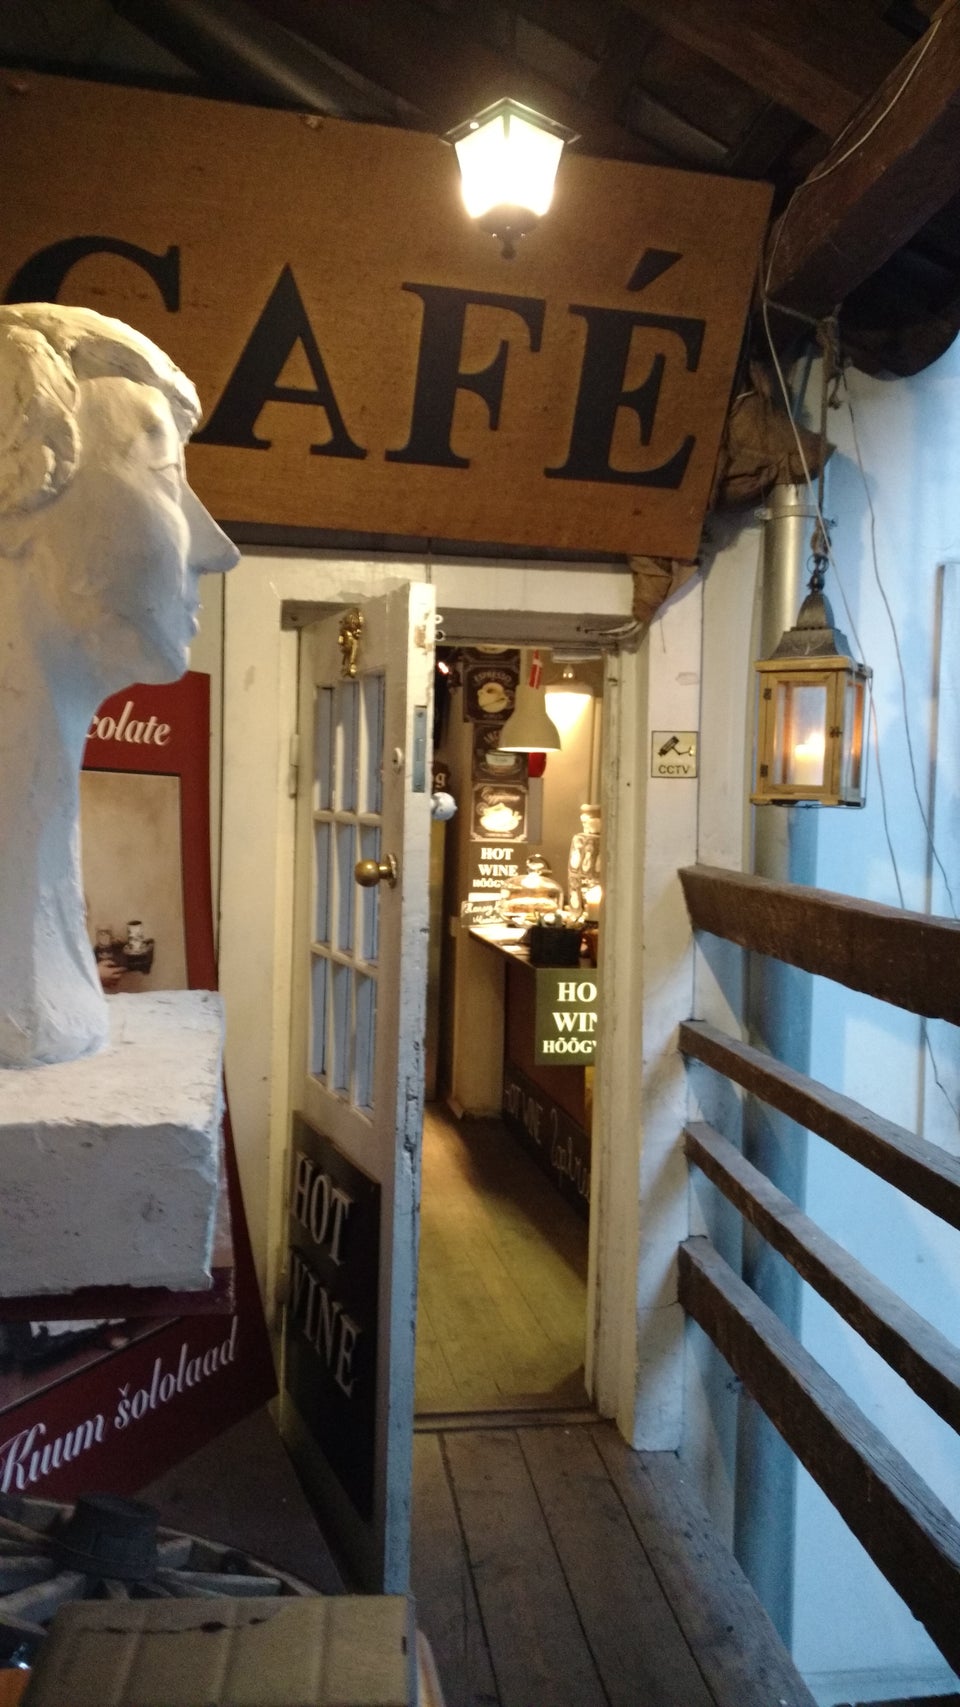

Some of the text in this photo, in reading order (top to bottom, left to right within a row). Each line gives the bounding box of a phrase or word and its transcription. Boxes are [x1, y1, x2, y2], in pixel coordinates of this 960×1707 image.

[658, 764, 691, 774] CCTV
[480, 847, 514, 860] HOT
[478, 864, 519, 877] WINE
[542, 1037, 597, 1054] HÕÕG
[291, 1150, 353, 1267] HOT
[0, 1422, 105, 1493] Kuum
